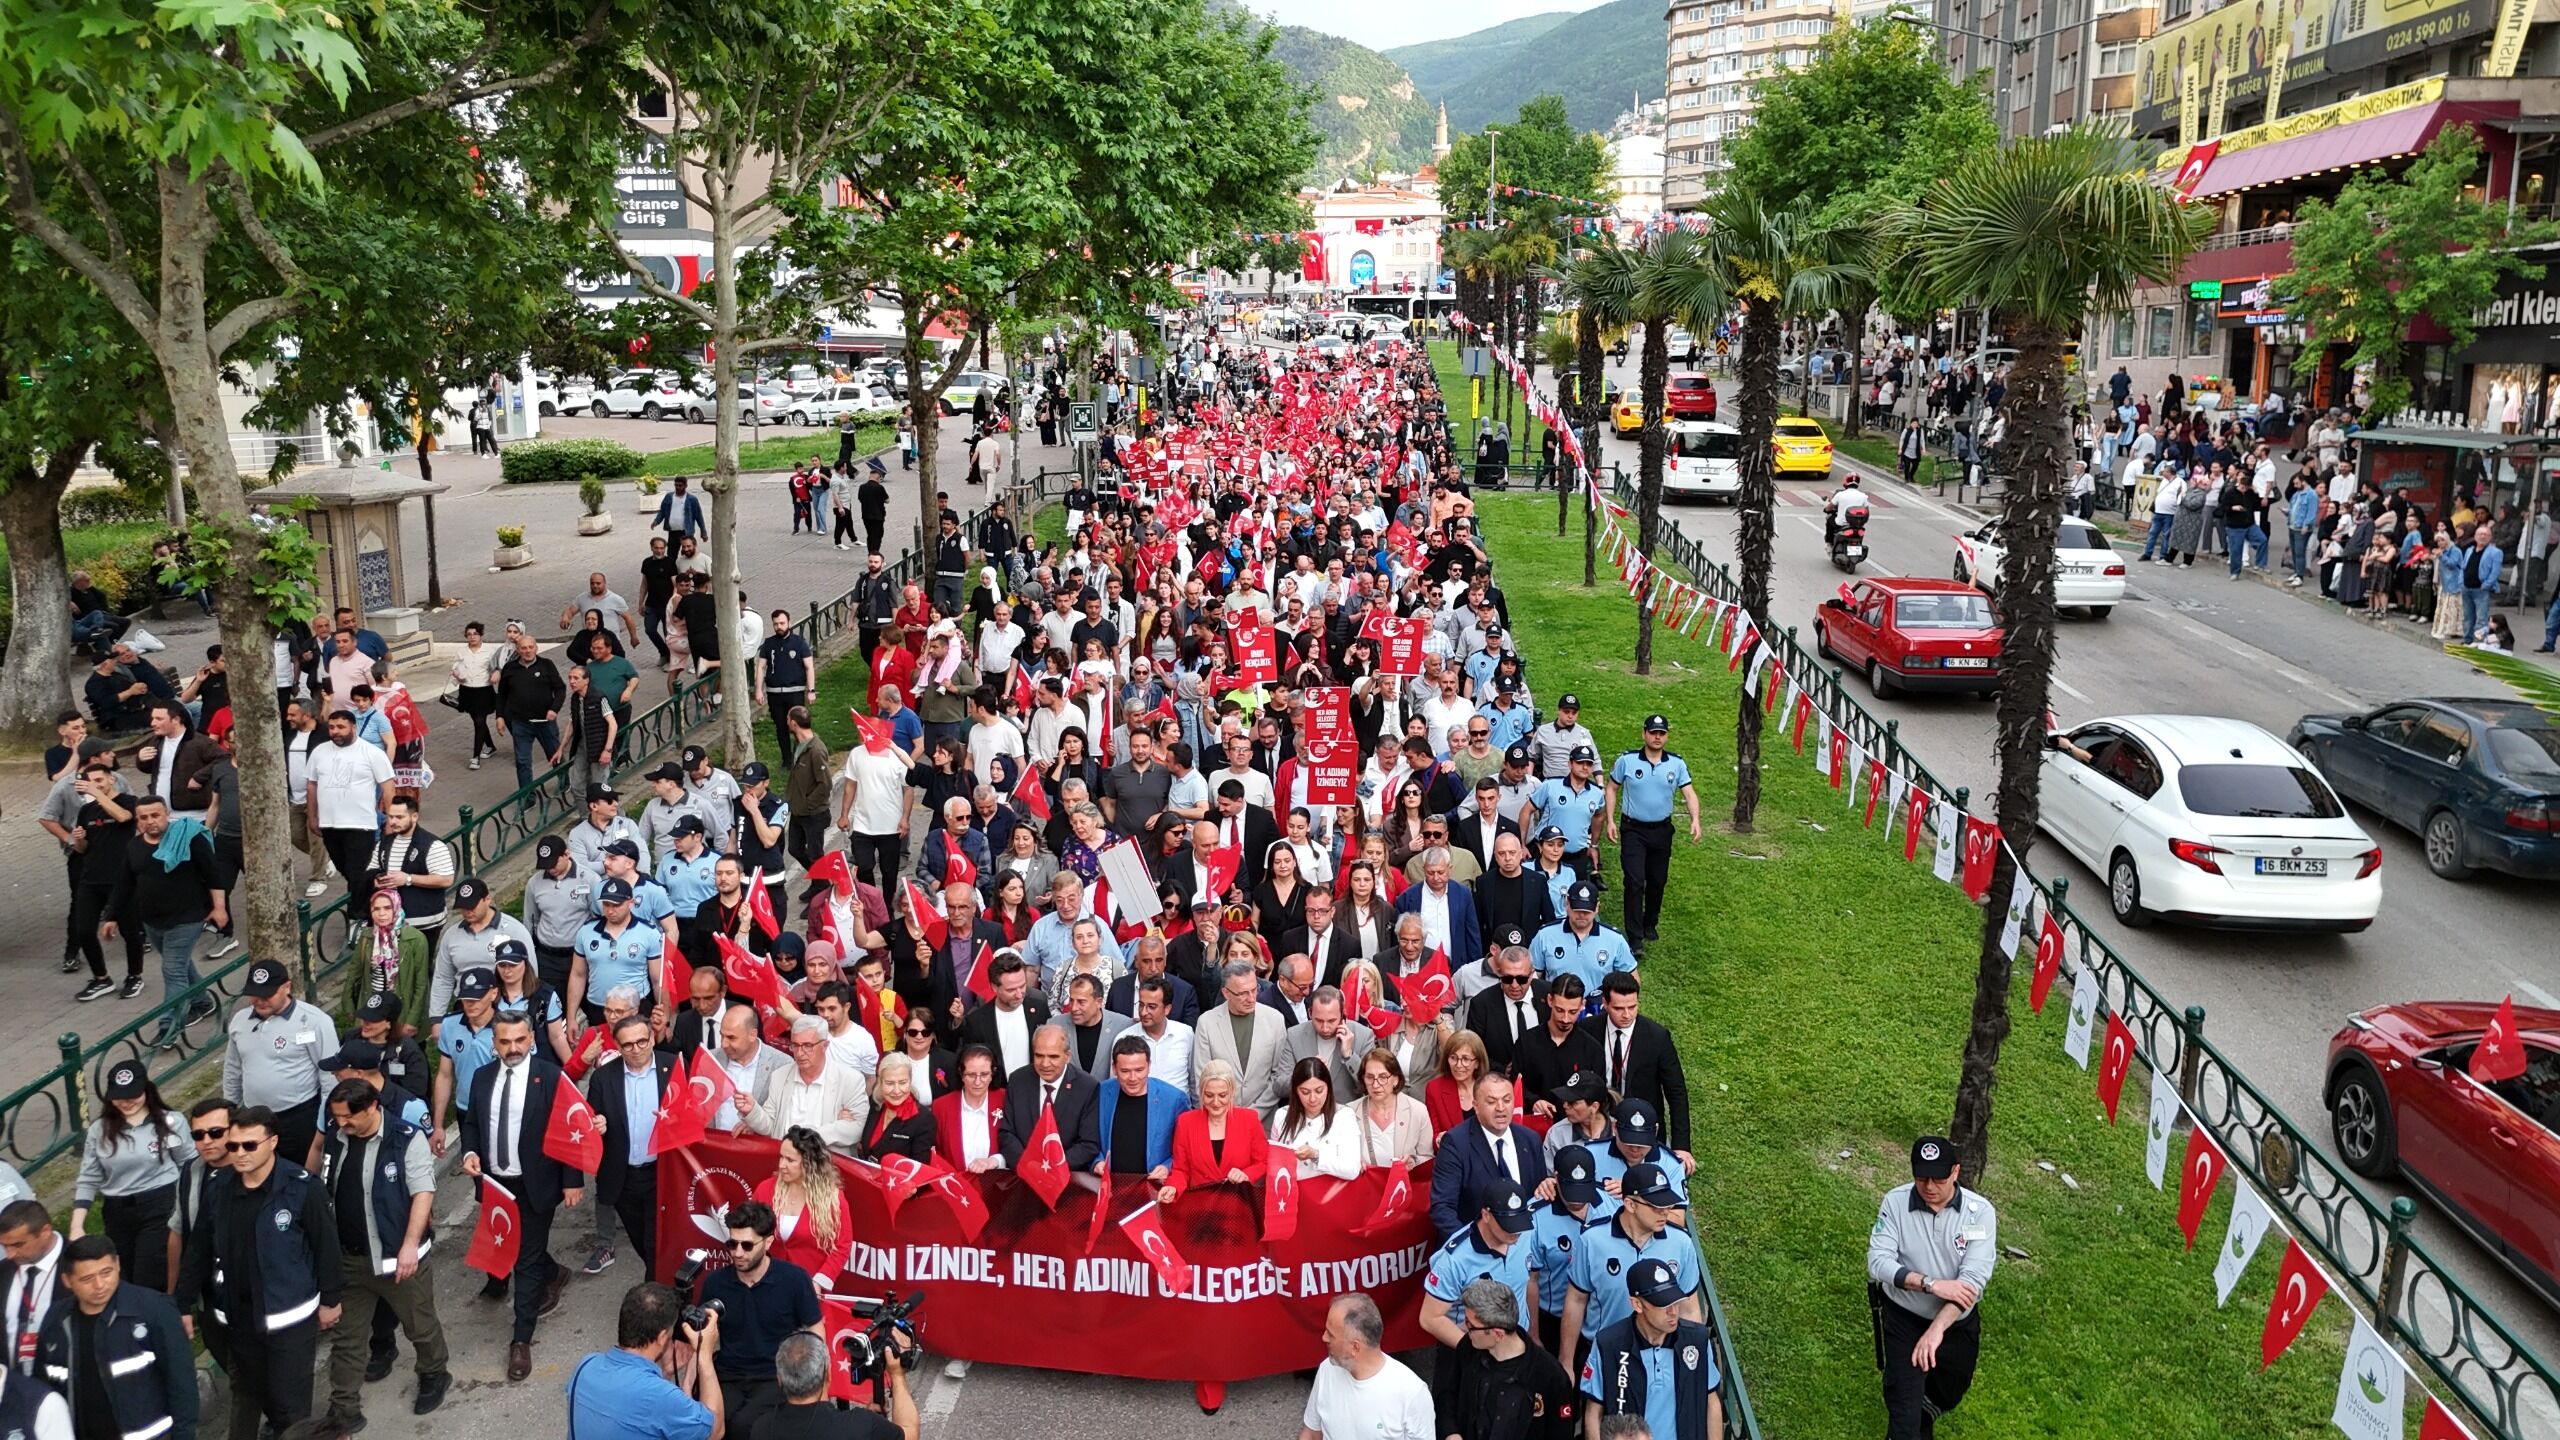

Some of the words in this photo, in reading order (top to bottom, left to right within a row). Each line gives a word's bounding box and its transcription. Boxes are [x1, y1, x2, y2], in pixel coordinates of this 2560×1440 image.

[2386, 31, 2413, 51] 0224
[2416, 23, 2436, 41] 599
[2438, 17, 2453, 35] 00
[2457, 11, 2470, 30] 16
[2292, 57, 2325, 80] KURUM
[2401, 84, 2425, 104] TIME
[623, 211, 667, 227] Giriş
[2263, 860, 2275, 871] 16
[2305, 861, 2326, 872] 253
[906, 1243, 1005, 1287] İZİNDE,
[1013, 1252, 1066, 1291] HER
[1073, 1257, 1150, 1297] ADIMI
[1300, 1240, 1429, 1298] ATIYORUZ
[1616, 1351, 1630, 1415] ZABIT
